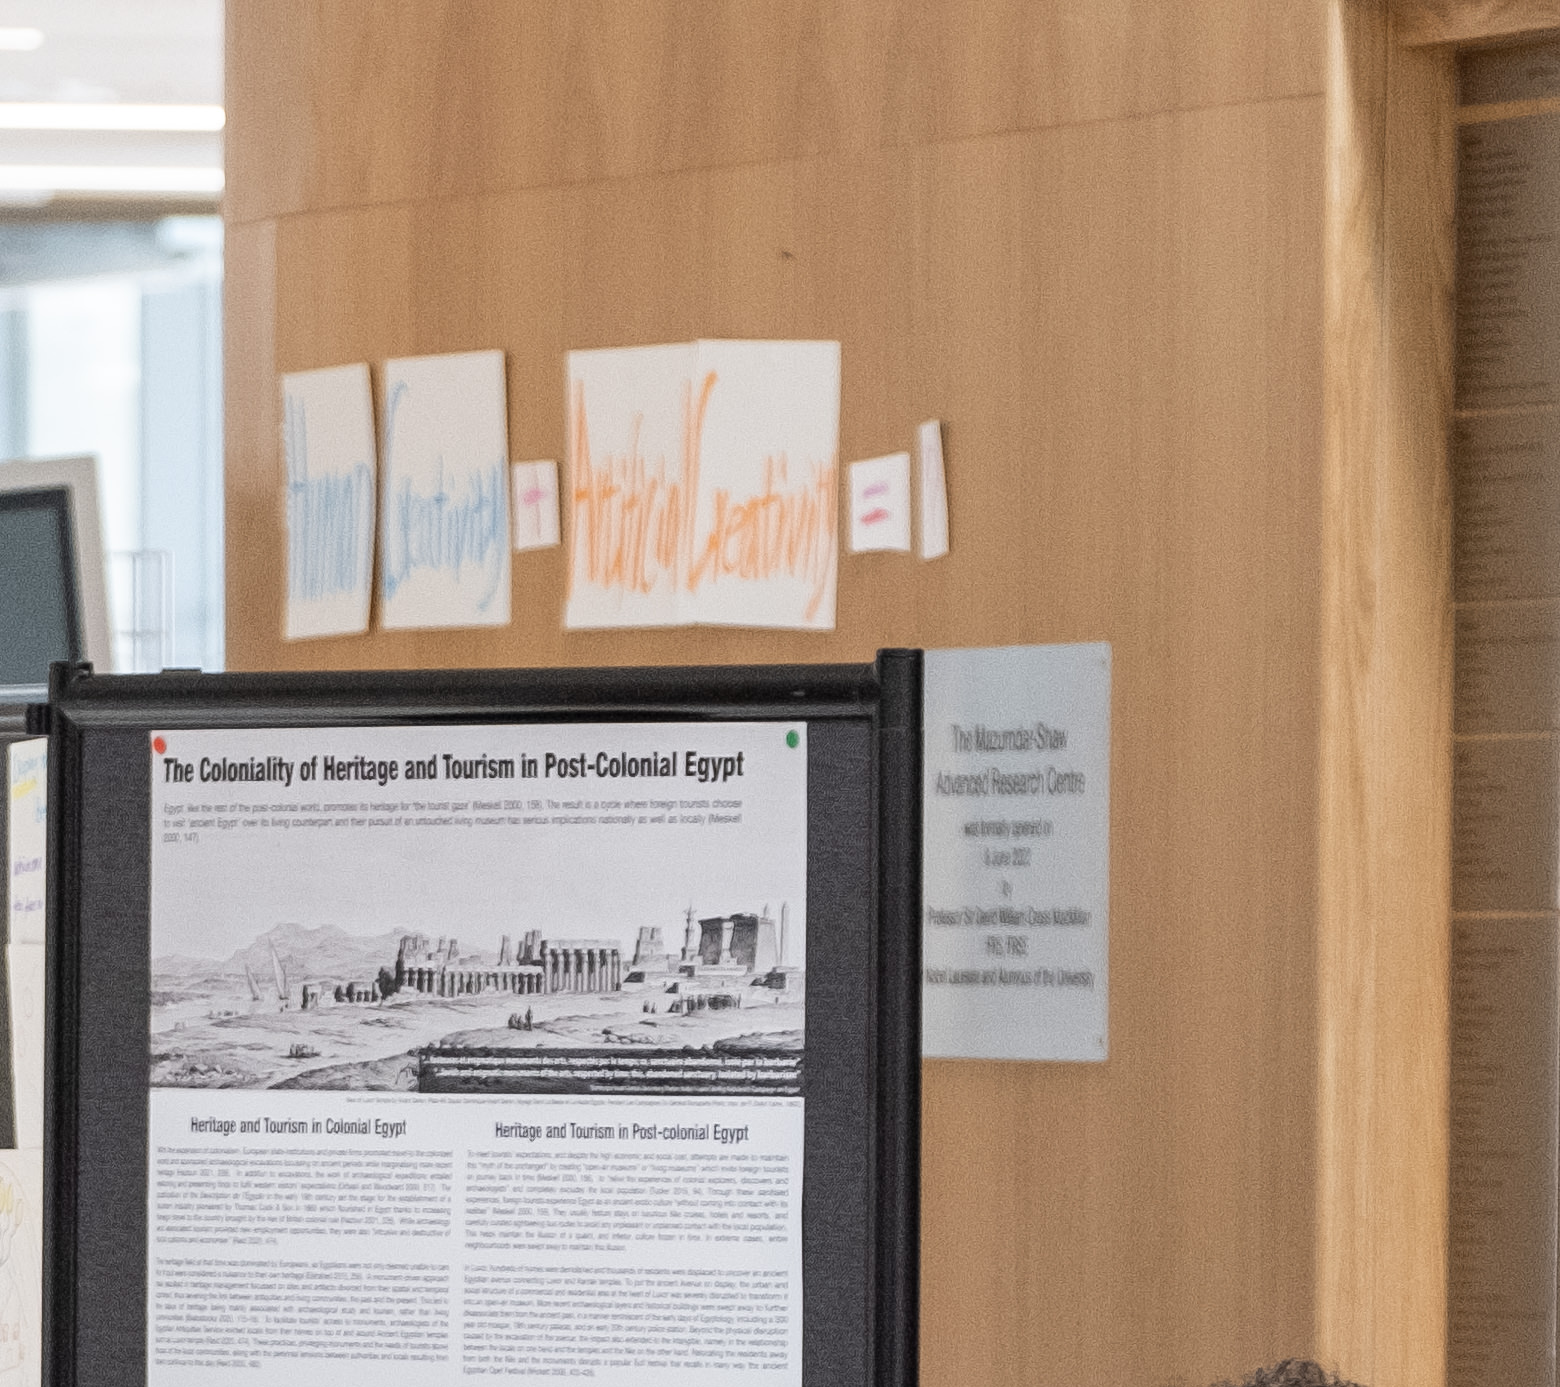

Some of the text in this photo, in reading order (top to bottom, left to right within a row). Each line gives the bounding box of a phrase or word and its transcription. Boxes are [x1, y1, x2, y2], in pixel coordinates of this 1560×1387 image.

[164, 750, 745, 787] The Coloniality of Heritage and Tourism in Post-Colonial Egypt
[190, 1116, 408, 1139] Heritage and Tourism in Colonial Egypt
[495, 1121, 750, 1144] Heritage and Tourism in Post-colonial Egypt
